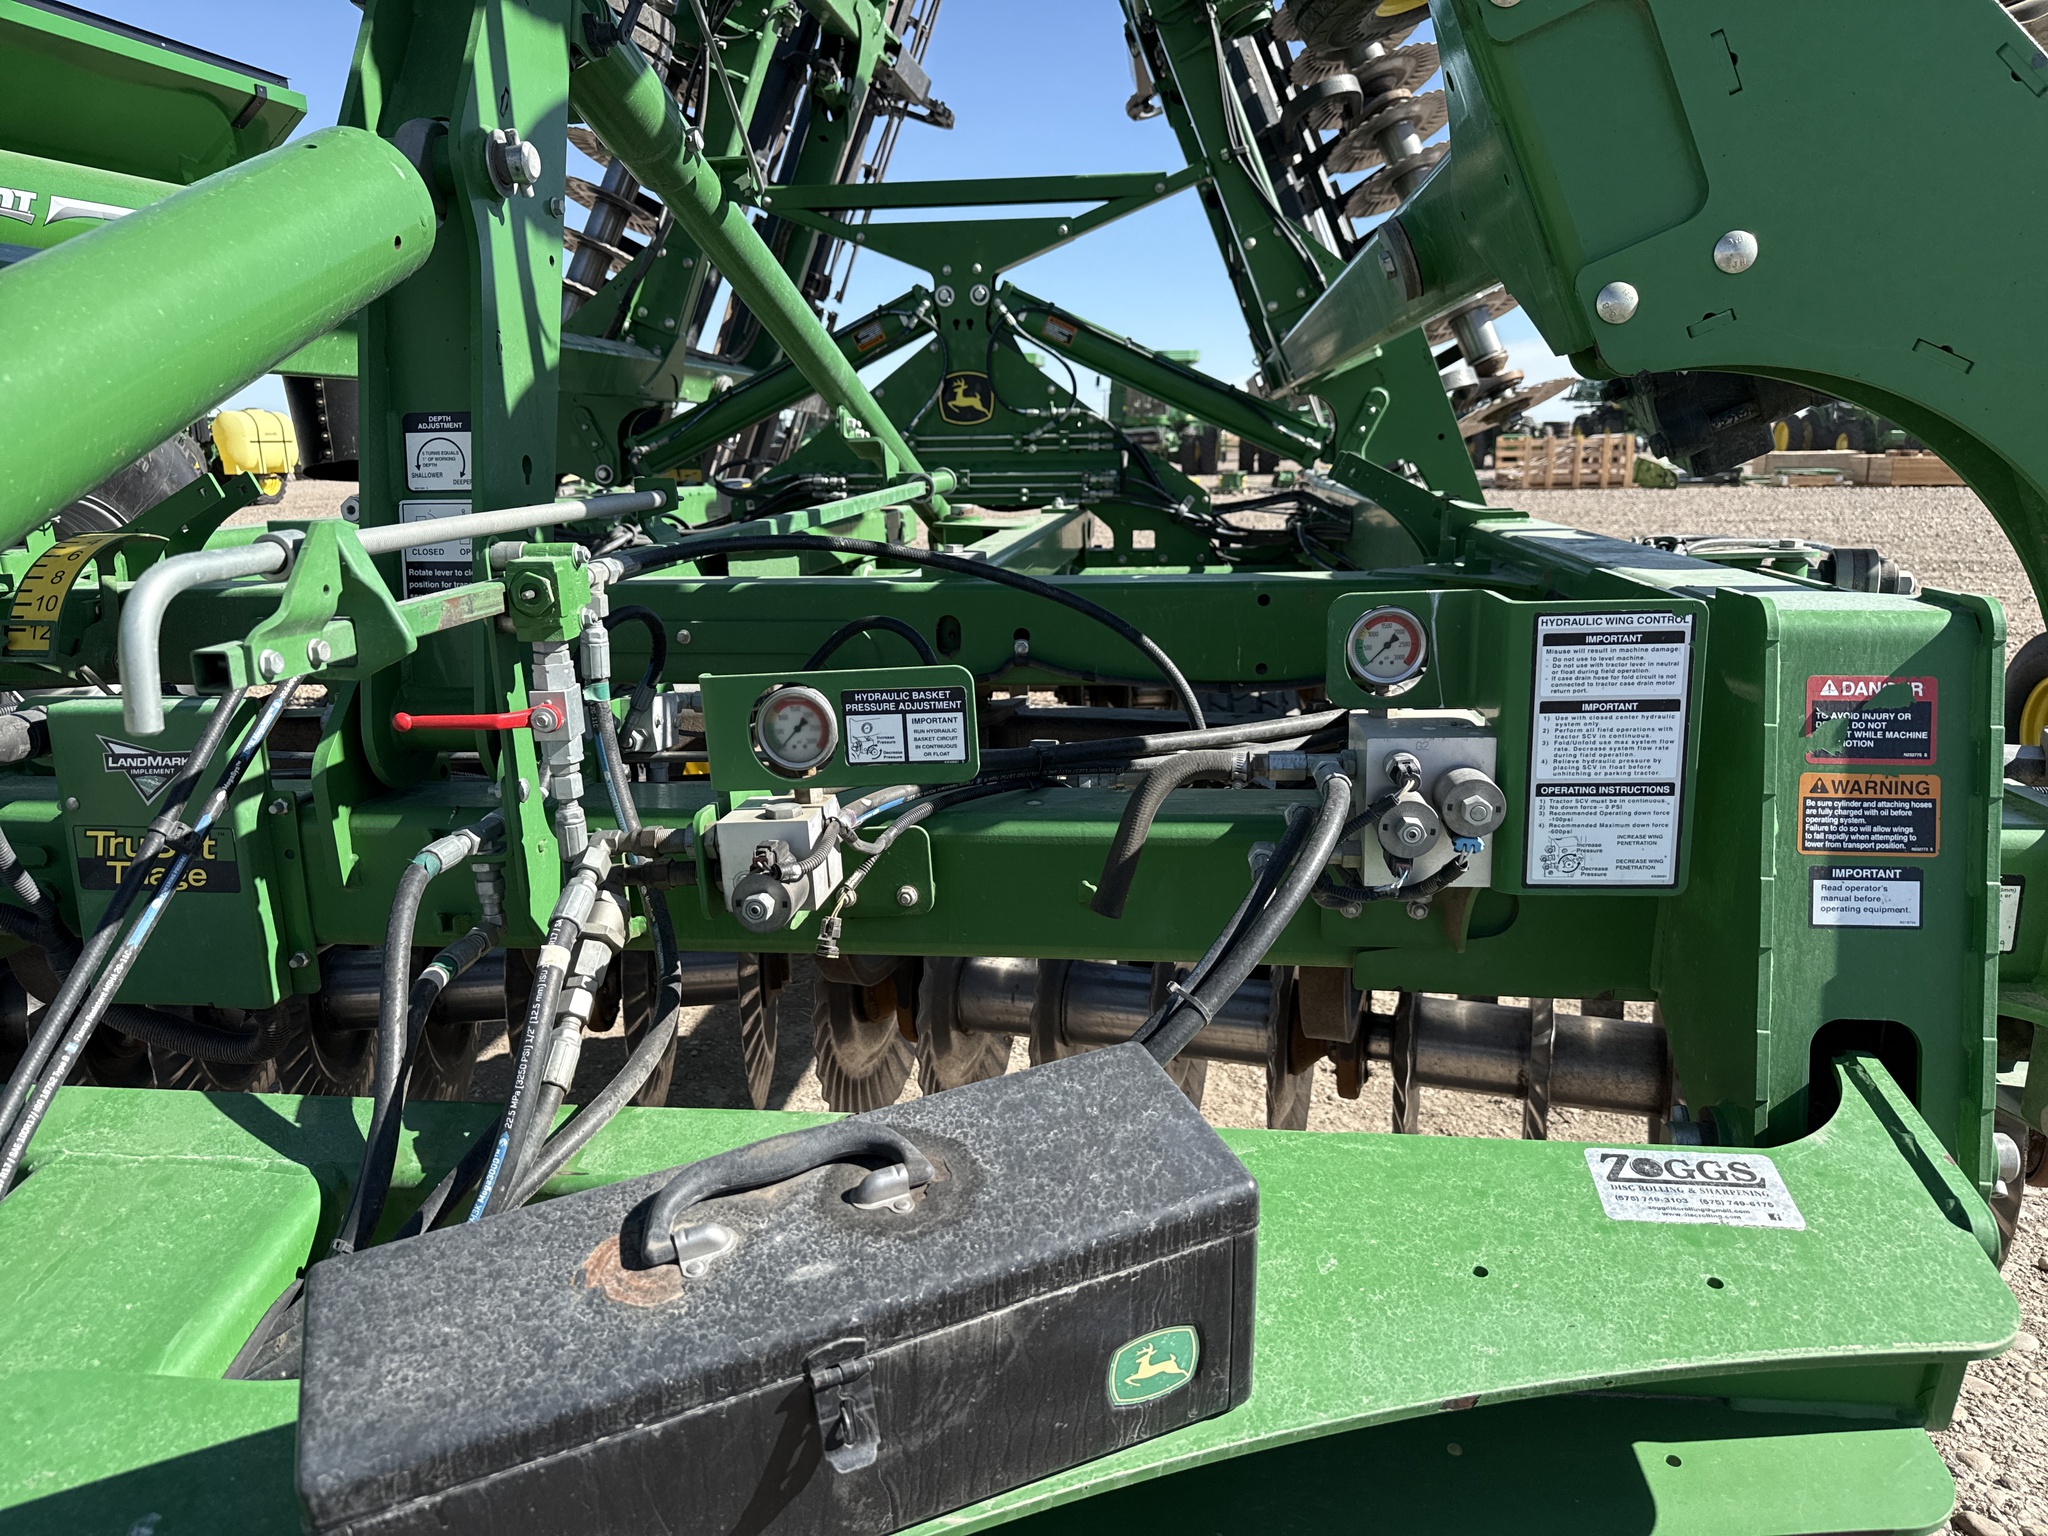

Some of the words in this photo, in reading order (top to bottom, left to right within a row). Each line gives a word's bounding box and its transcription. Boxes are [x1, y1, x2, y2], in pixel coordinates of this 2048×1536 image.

[68, 551, 83, 560] 6
[51, 571, 65, 584] 8
[37, 595, 58, 611] 10
[1541, 618, 1603, 626] HYDRAULIC
[1605, 617, 1633, 625] WING
[1636, 615, 1689, 624] CONTROL
[30, 626, 50, 640] 12
[1586, 634, 1642, 643] IMPORTANT
[1842, 682, 1923, 696] DANR
[855, 692, 909, 701] HYDRAULIC
[913, 691, 950, 699] BASKET
[846, 703, 895, 711] PRESSURE
[898, 701, 961, 710] ADJUSTMENT
[1582, 702, 1638, 711] IMPORTANT
[1416, 741, 1429, 750] G2
[1541, 786, 1596, 794] OPERATING
[1599, 786, 1670, 794] INSTRUCTIONS
[1831, 780, 1930, 795] WARNING
[1834, 800, 1861, 808] cylinder
[1877, 801, 1909, 809] attaching
[1818, 808, 1832, 816] fully
[1806, 816, 1838, 825] operating
[1893, 826, 1913, 834] wings
[1814, 832, 1824, 840] fall
[1826, 833, 1849, 841] rapidly
[1871, 834, 1908, 842] attempting
[1843, 842, 1875, 850] transport
[1876, 842, 1906, 850] position.
[1832, 869, 1901, 879] IMPORTANT
[1821, 884, 1842, 892] Read
[1845, 885, 1888, 893] operator's
[1821, 905, 1861, 914] operating
[1863, 906, 1910, 914] equipment.
[73, 1022, 90, 1041] Flame
[85, 991, 108, 1022] Resistant
[102, 973, 118, 993] MSHA
[9, 1142, 22, 1159] SAE
[33, 1100, 45, 1112] ISO
[43, 1077, 58, 1100] 18752
[52, 1063, 65, 1078] Type
[505, 1110, 515, 1129] 22.5
[510, 1091, 521, 1109] MPa
[1600, 1153, 1766, 1189] ZOGGS
[1638, 1185, 1684, 1193] ROLLING
[1700, 1188, 1770, 1197] SHARPENING
[1643, 1196, 1689, 1204] 749-3103
